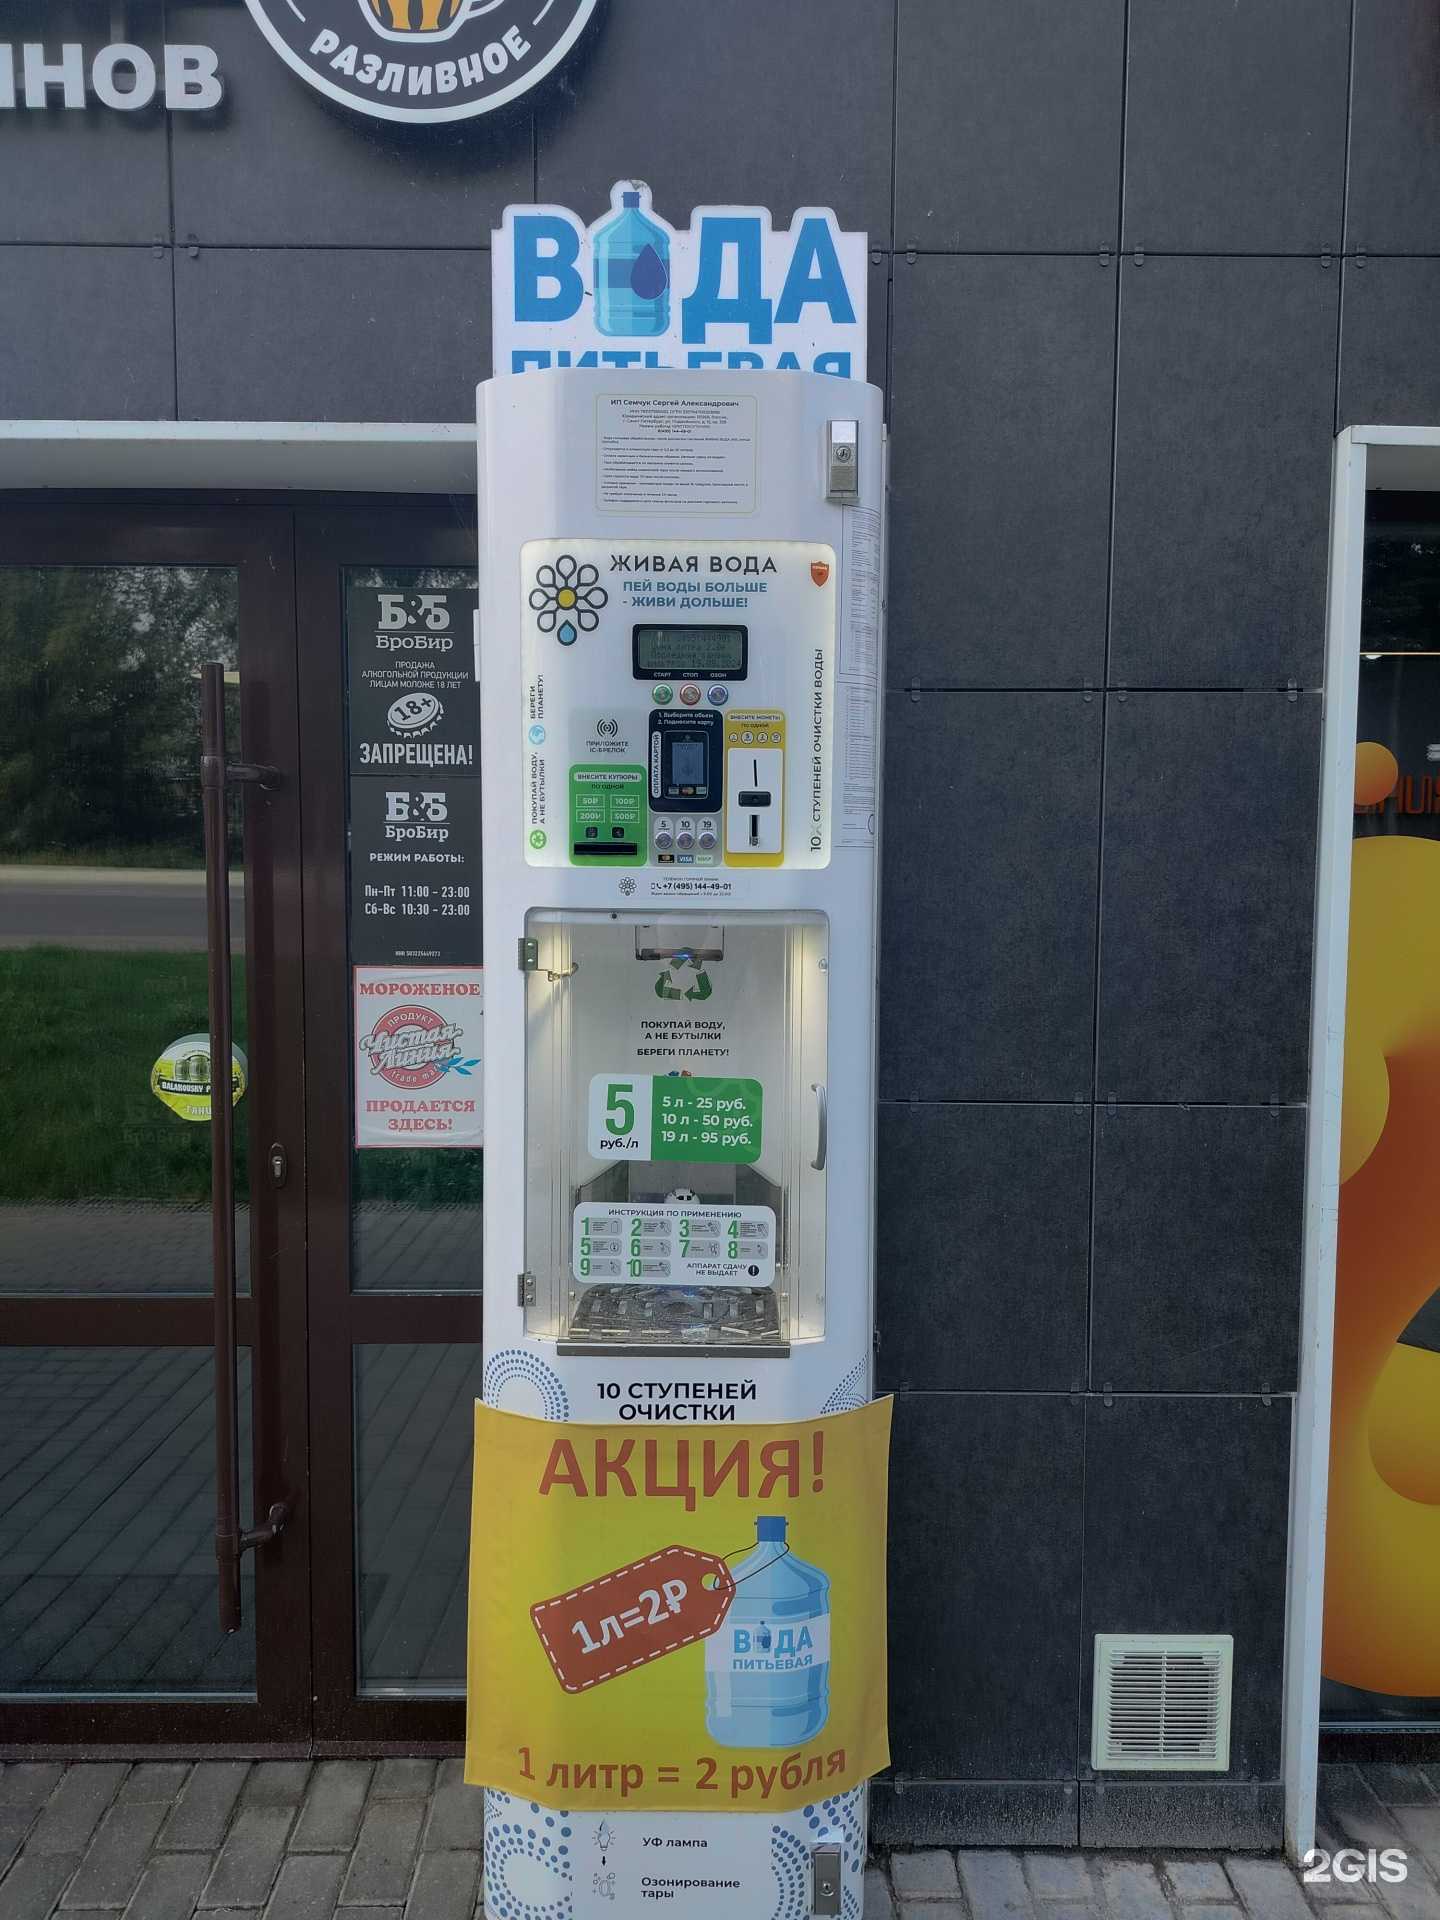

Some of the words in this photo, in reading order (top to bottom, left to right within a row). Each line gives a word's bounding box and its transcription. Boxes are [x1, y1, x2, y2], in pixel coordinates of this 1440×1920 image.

[310, 24, 531, 96] РАЗЛИВНОЕ
[609, 554, 699, 573] ЖИВАЯ
[710, 556, 778, 575] ВОДА
[623, 581, 652, 593] ПЕЙ
[656, 581, 701, 594] ВОДЫ
[705, 582, 768, 594] БОЛЬШЕ
[631, 597, 677, 608] ЖИВИ
[680, 597, 749, 609] ДОЛЬШЕ!
[375, 634, 454, 652] БроБир
[395, 661, 435, 670] ПРОДАЖА
[814, 648, 824, 689] ВОДЫ
[361, 670, 419, 679] АЛКОГОЛЬНОЙ
[420, 671, 469, 680] ПРОДУКЦИИ
[369, 680, 399, 689] ЛИЦАМ
[400, 681, 435, 689] МОЛОЖЕ
[436, 681, 445, 689] 18
[446, 681, 461, 689] ЛЕТ
[394, 697, 433, 721] 18+
[813, 692, 823, 753] ОЧИСТКИ
[359, 742, 473, 767] ЗАПРЕЩЕНА!
[812, 756, 822, 822] СТУПЕНЕЙ
[661, 820, 667, 828] 5
[681, 820, 690, 828] 10
[703, 820, 712, 828] 19
[384, 824, 450, 842] БроБир
[369, 853, 411, 863] РЕЖИМ
[414, 853, 465, 864] РАБОТЫ:
[364, 884, 396, 898] Пн-Пт
[401, 885, 430, 898] 11:00
[441, 885, 470, 899] 23:00
[662, 882, 672, 890] +7
[673, 882, 693, 891] (495)
[694, 882, 732, 891] 144-49-01
[364, 902, 396, 917] Сб-Вс
[401, 903, 430, 917] 10:30
[441, 903, 470, 917] 23:00
[359, 983, 481, 996] МОРОЖЕНОЕ
[388, 1012, 434, 1028] ПРОДУКТ
[640, 1020, 692, 1029] ПОКУПАЙ
[694, 1021, 726, 1030] ВОДУ,
[644, 1032, 652, 1040] А
[671, 1032, 722, 1040] БУТЫЛКИ
[637, 1048, 676, 1056] БЕРЕГИ
[678, 1048, 730, 1057] ПЛАНЕТУ!
[366, 1100, 475, 1115] ПРОДАЕТСЯ
[605, 1084, 635, 1136] 5
[662, 1096, 672, 1107] 5
[673, 1099, 684, 1108] л
[696, 1097, 713, 1109] 25
[716, 1098, 747, 1113] руб.
[388, 1118, 453, 1133] ЗДЕСЬ!
[661, 1113, 677, 1125] 10
[679, 1116, 690, 1126] л
[702, 1115, 720, 1126] 50
[723, 1115, 753, 1130] руб.
[600, 1137, 639, 1150] руб./л
[661, 1130, 676, 1142] 19
[679, 1133, 689, 1143] л
[700, 1132, 719, 1144] 95
[721, 1132, 752, 1147] руб.
[608, 1208, 664, 1218] ИНСТРУКЦИЯ
[680, 1210, 742, 1219] ПРИМЕНЕНИЮ
[581, 1217, 590, 1236] 1
[630, 1218, 642, 1237] 2
[679, 1219, 690, 1238] 3
[727, 1220, 739, 1239] 4
[580, 1237, 591, 1256] 5
[630, 1238, 641, 1257] 6
[679, 1239, 690, 1258] 7
[727, 1241, 738, 1259] 8
[580, 1258, 591, 1276] 9
[626, 1259, 642, 1278] 10
[722, 1263, 747, 1272] СДАЧУ
[596, 1382, 621, 1400] 10
[628, 1379, 757, 1400] СТУПЕНЕЙ
[619, 1403, 736, 1422] ОЧИСТКИ
[539, 1431, 825, 1512] АКЦИЯ!
[732, 1654, 813, 1672] ПИТЬЕВАЯ
[518, 1746, 536, 1781] 1
[546, 1762, 644, 1798] литр
[658, 1766, 680, 1783] =
[695, 1757, 719, 1790] 2
[730, 1748, 847, 1799] рубля
[642, 1837, 663, 1849] УФ
[666, 1838, 708, 1849] лампа
[641, 1876, 741, 1890] Озонирование
[641, 1889, 675, 1900] тары
